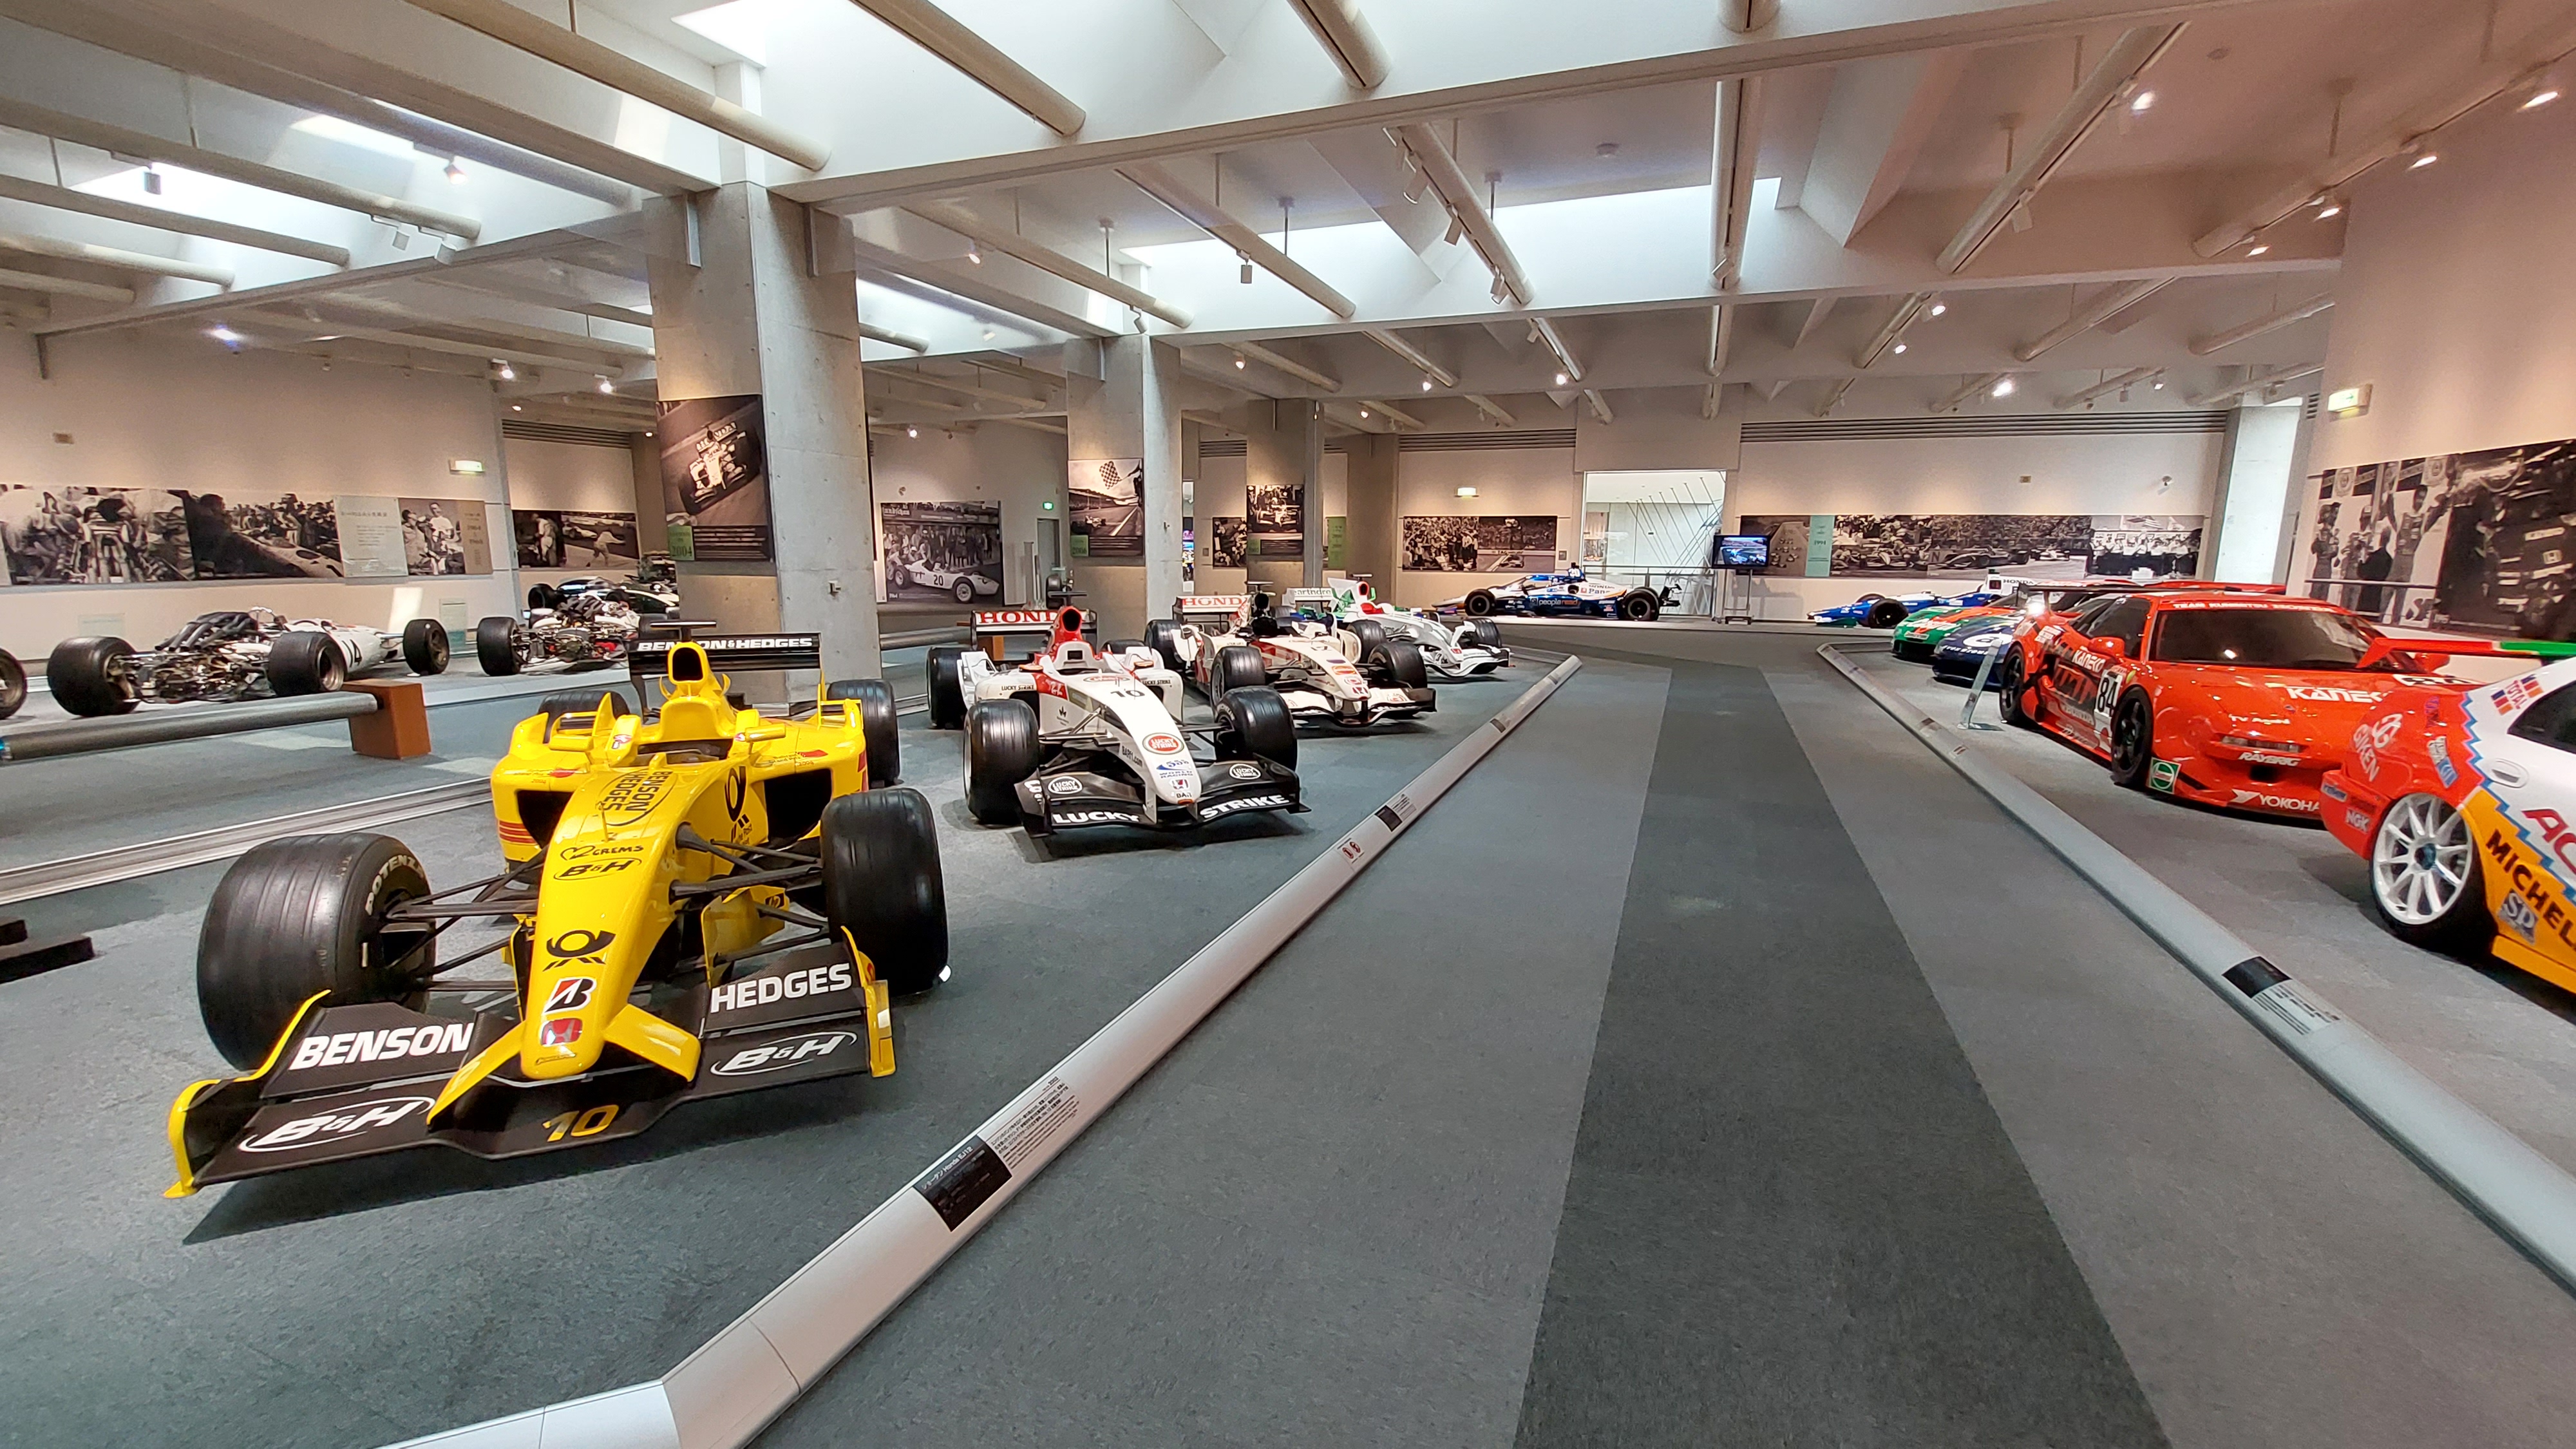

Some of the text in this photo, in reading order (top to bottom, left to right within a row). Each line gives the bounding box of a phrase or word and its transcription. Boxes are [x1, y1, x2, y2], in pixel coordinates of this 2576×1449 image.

[934, 574, 943, 586] 20
[1110, 690, 1146, 698] 10
[2096, 677, 2118, 717] 84
[2506, 679, 2528, 710] TOTAL
[602, 773, 647, 811] HEDGES
[624, 771, 673, 811] BENSON
[1200, 794, 1290, 819] STRIKE
[1052, 811, 1139, 824] LUCKY
[2345, 809, 2370, 833] NGK
[558, 860, 635, 878] B&H
[710, 963, 852, 1014] HEDGES
[289, 1022, 474, 1070] BENSON
[719, 1034, 844, 1072] B&H
[249, 1100, 424, 1148] B&H
[542, 1104, 619, 1142] 10
[942, 1157, 960, 1173] Honda
[957, 1146, 974, 1160] EJ12
